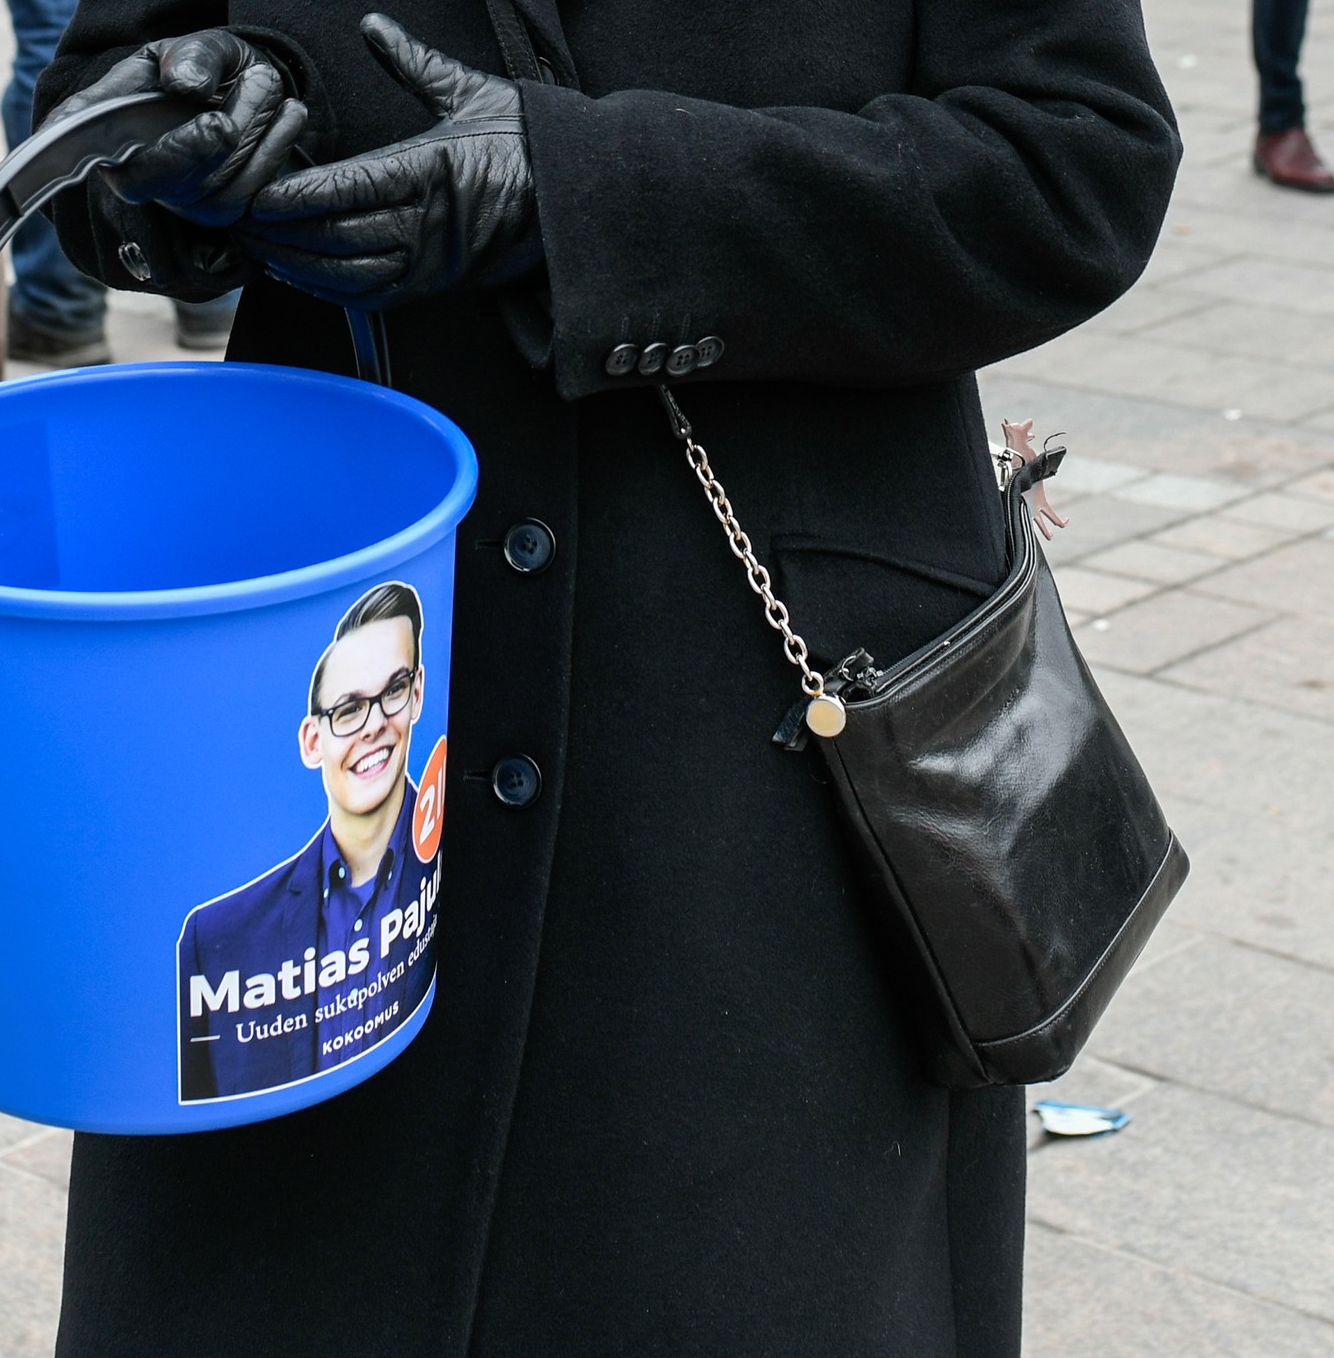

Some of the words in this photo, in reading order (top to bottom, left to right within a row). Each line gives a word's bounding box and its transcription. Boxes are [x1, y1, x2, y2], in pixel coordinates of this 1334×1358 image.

[189, 937, 370, 1018] Matias
[235, 1012, 308, 1043] Uuden
[314, 960, 405, 1024] sukupolven
[322, 1000, 399, 1056] KOKOOMUS
